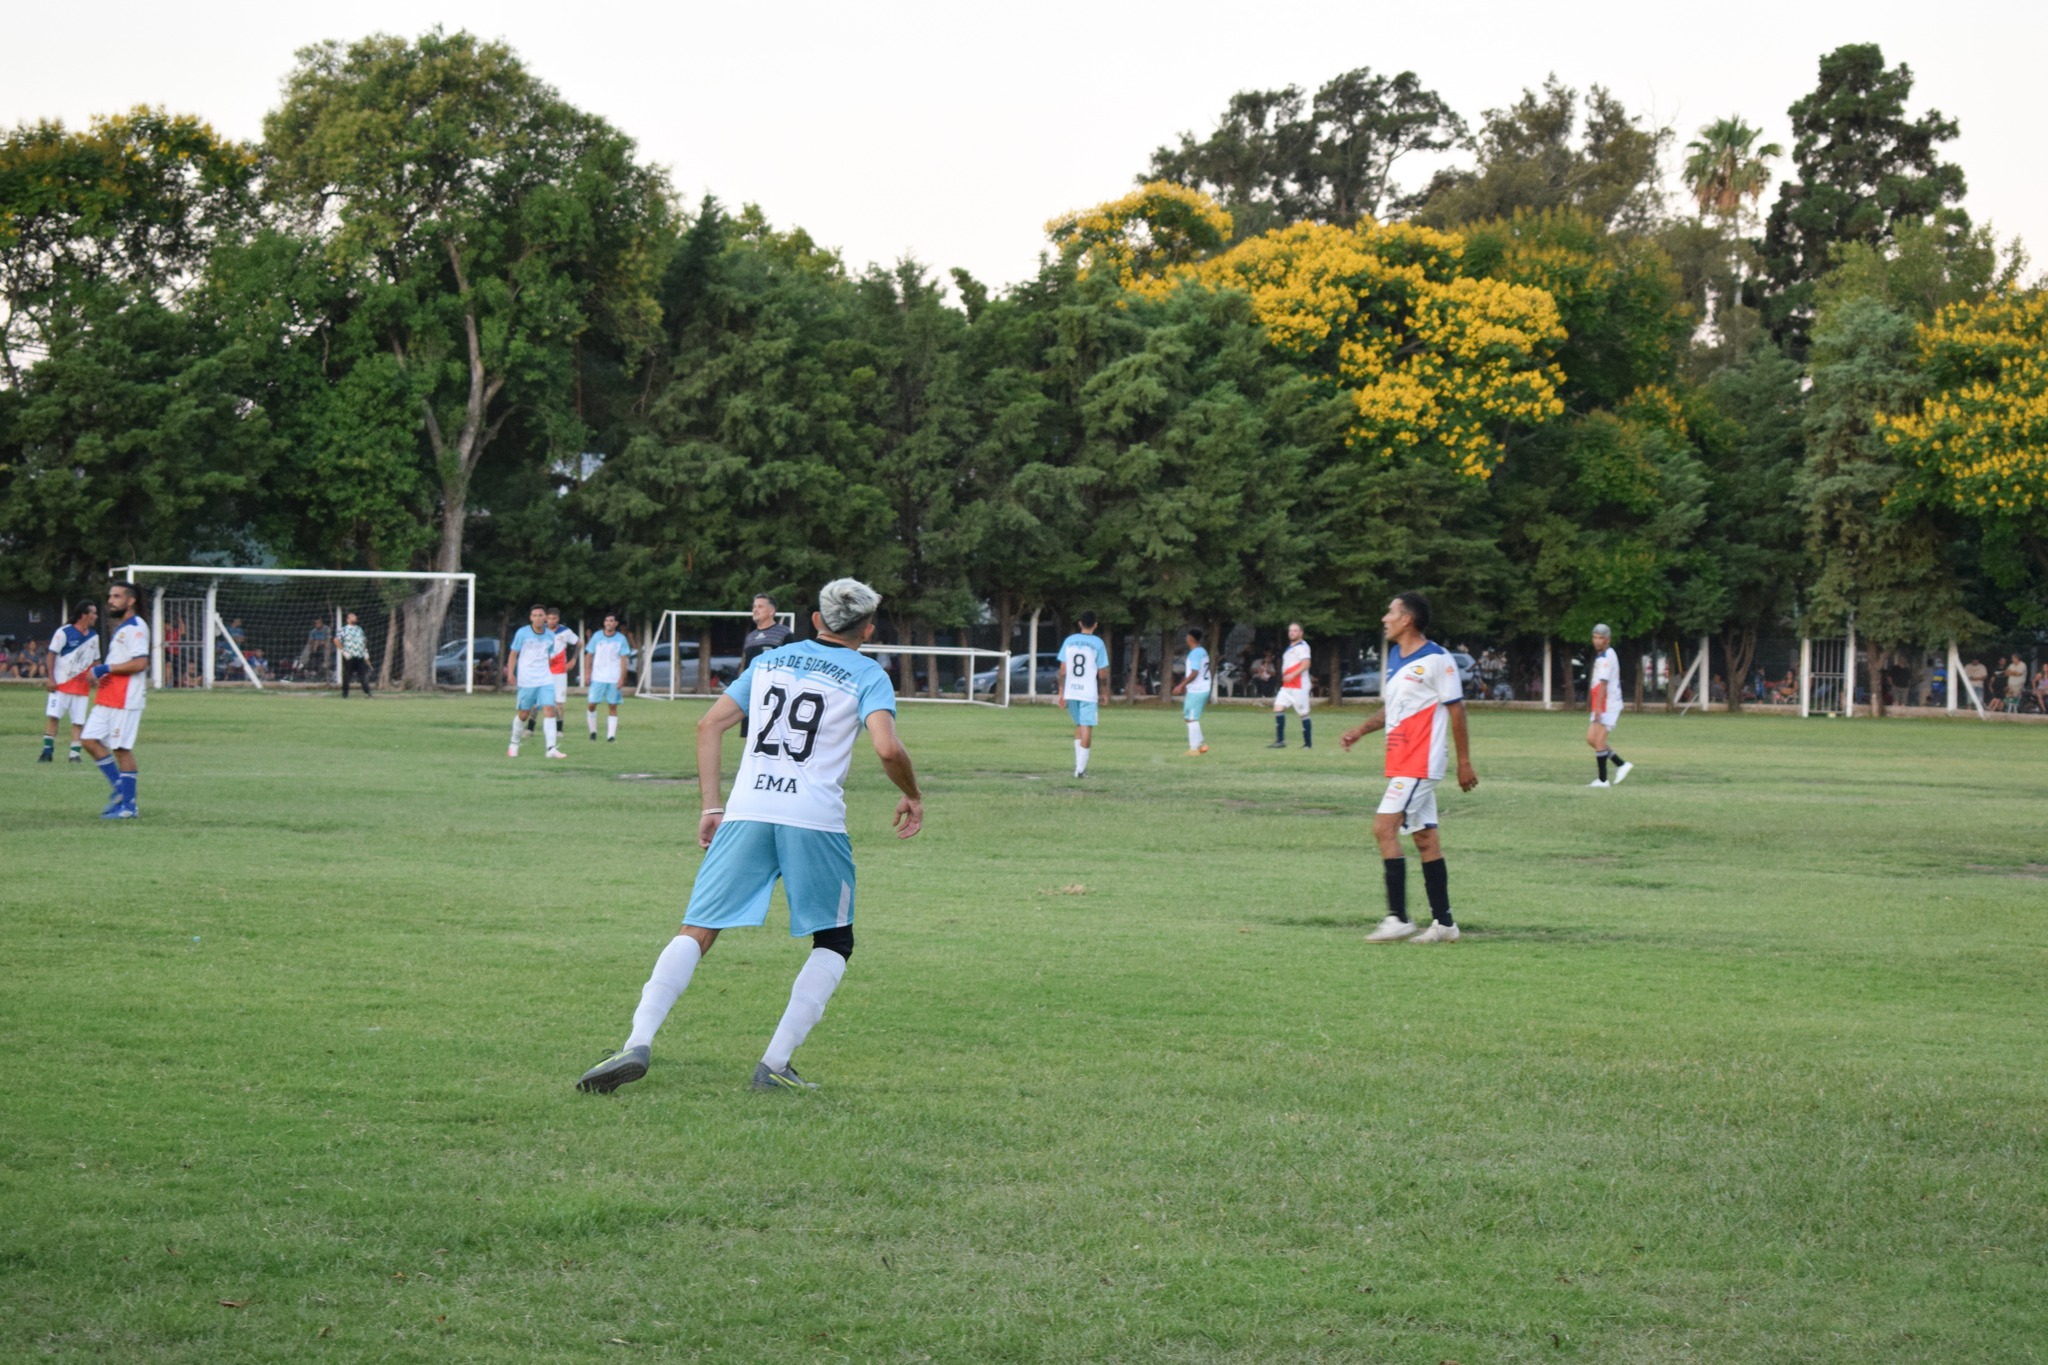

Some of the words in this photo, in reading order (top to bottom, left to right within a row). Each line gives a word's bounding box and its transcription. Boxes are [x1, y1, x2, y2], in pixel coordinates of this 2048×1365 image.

[787, 655, 804, 669] DE
[803, 657, 852, 684] SIEMPRE
[1073, 653, 1085, 677] 8
[752, 684, 826, 765] 29
[754, 774, 798, 794] EMA
